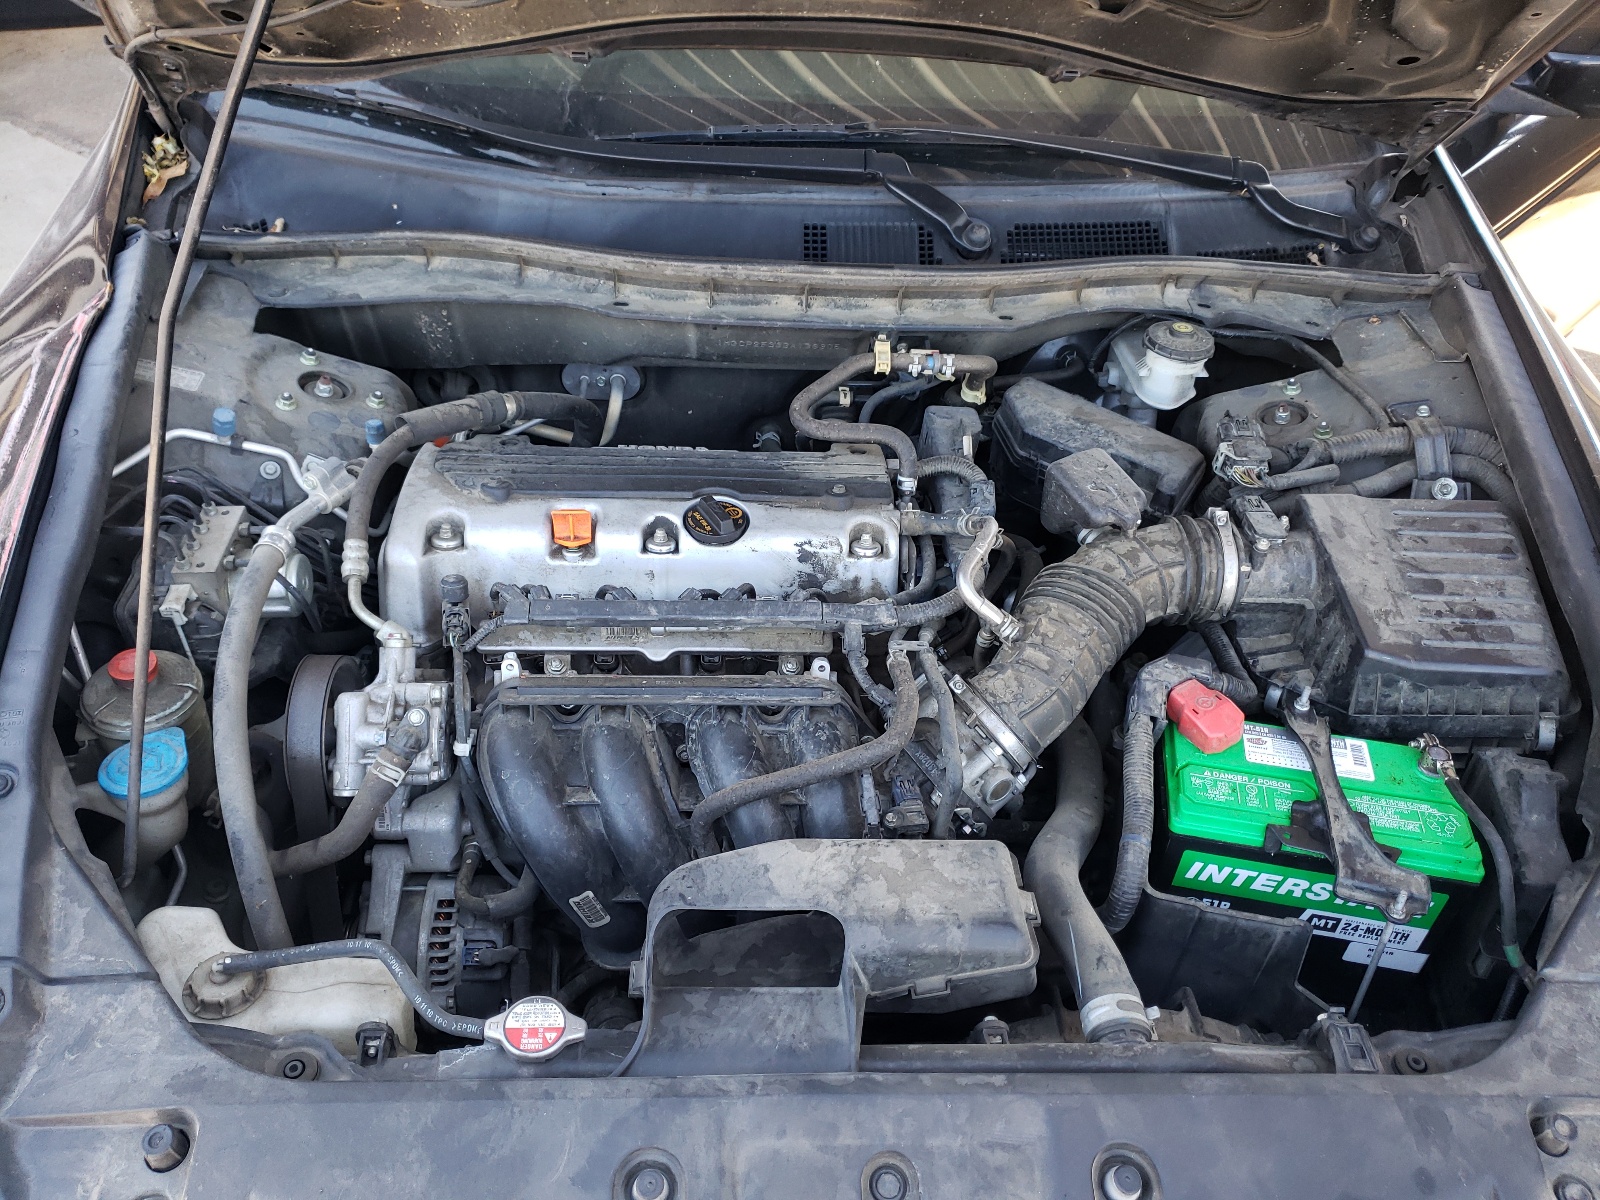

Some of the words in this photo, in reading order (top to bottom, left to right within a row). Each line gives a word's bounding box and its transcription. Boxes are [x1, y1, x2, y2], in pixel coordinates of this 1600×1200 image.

[1212, 770, 1249, 783] DANGER
[1258, 778, 1292, 790] POISON
[1309, 917, 1337, 930] MT
[1341, 922, 1411, 942] 24-MOTH
[1338, 930, 1356, 938] FREE
[1357, 934, 1406, 946] REPLAMENT
[414, 994, 422, 1005] 10
[419, 1002, 427, 1010] 11
[426, 1008, 435, 1018] 10
